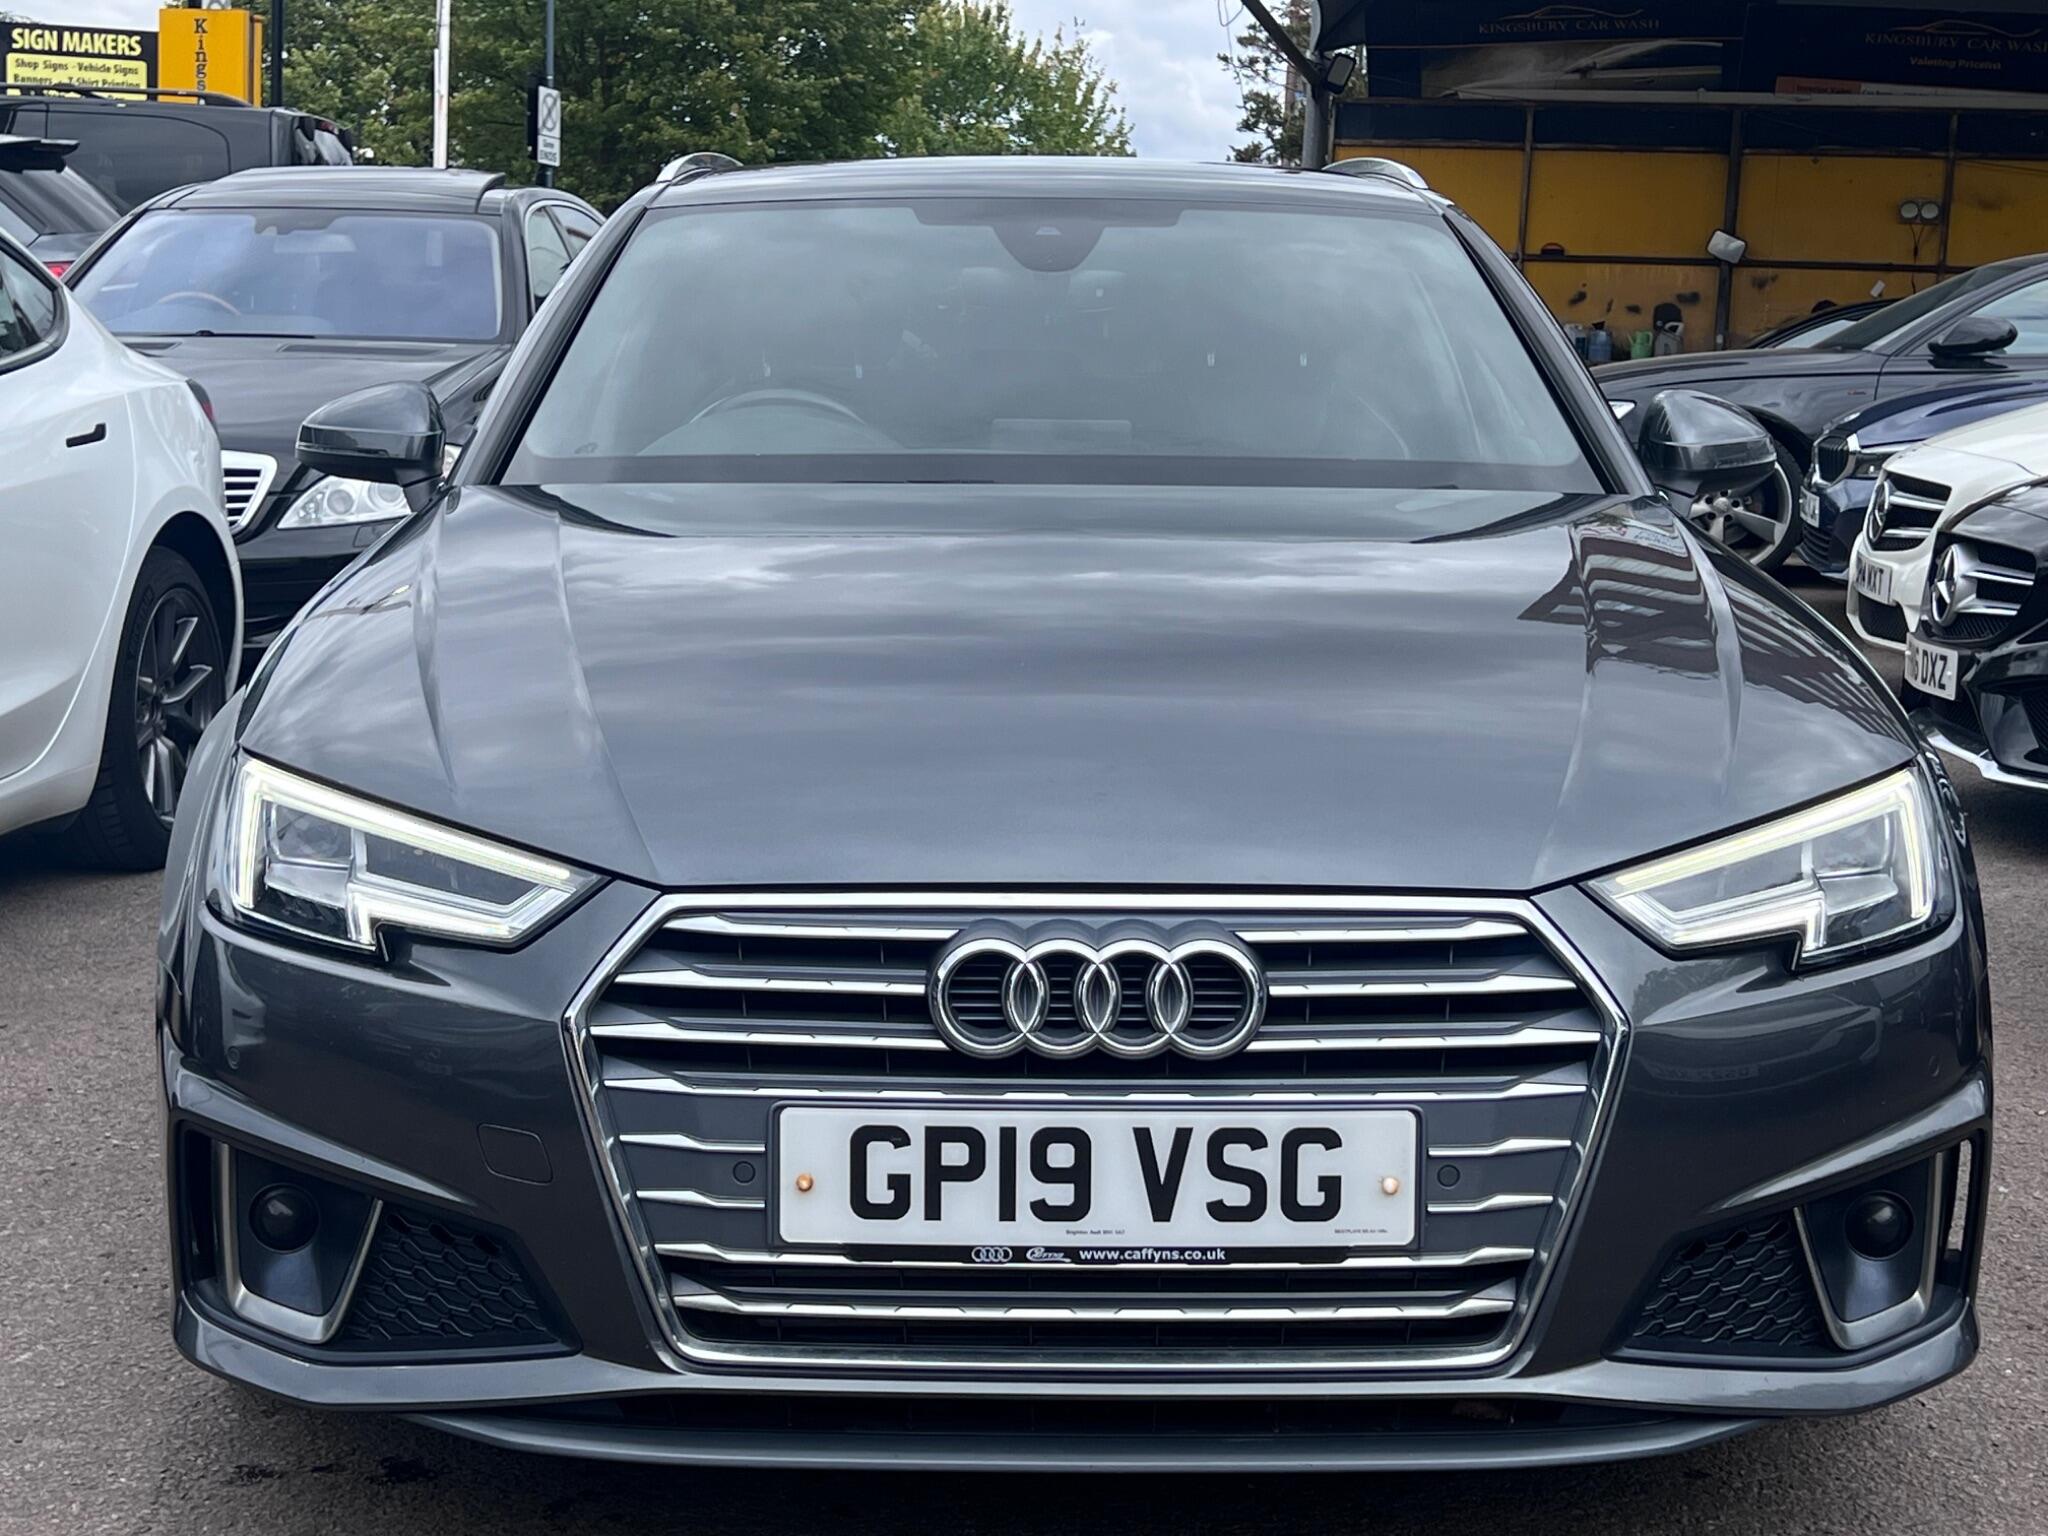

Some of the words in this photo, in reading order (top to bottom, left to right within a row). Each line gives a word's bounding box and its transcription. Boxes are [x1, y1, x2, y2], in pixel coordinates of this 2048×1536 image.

[1478, 20, 1567, 34] KINGSBURY
[1575, 19, 1609, 31] CAR
[1613, 19, 1660, 30] WASH
[11, 27, 58, 51] SIGN
[62, 31, 142, 56] MAKERS
[1865, 33, 1959, 48] KINGSBURY
[1967, 38, 2002, 49] CAR
[15, 58, 38, 70] Shop
[42, 59, 69, 72] Signs
[76, 62, 112, 73] Vehicle
[113, 64, 139, 76] Signs
[1920, 648, 1948, 691] DXZ
[849, 1124, 1092, 1222] GP19
[1133, 1126, 1344, 1223] VSG
[1079, 1248, 1225, 1263] www.caffyns.co.uk
